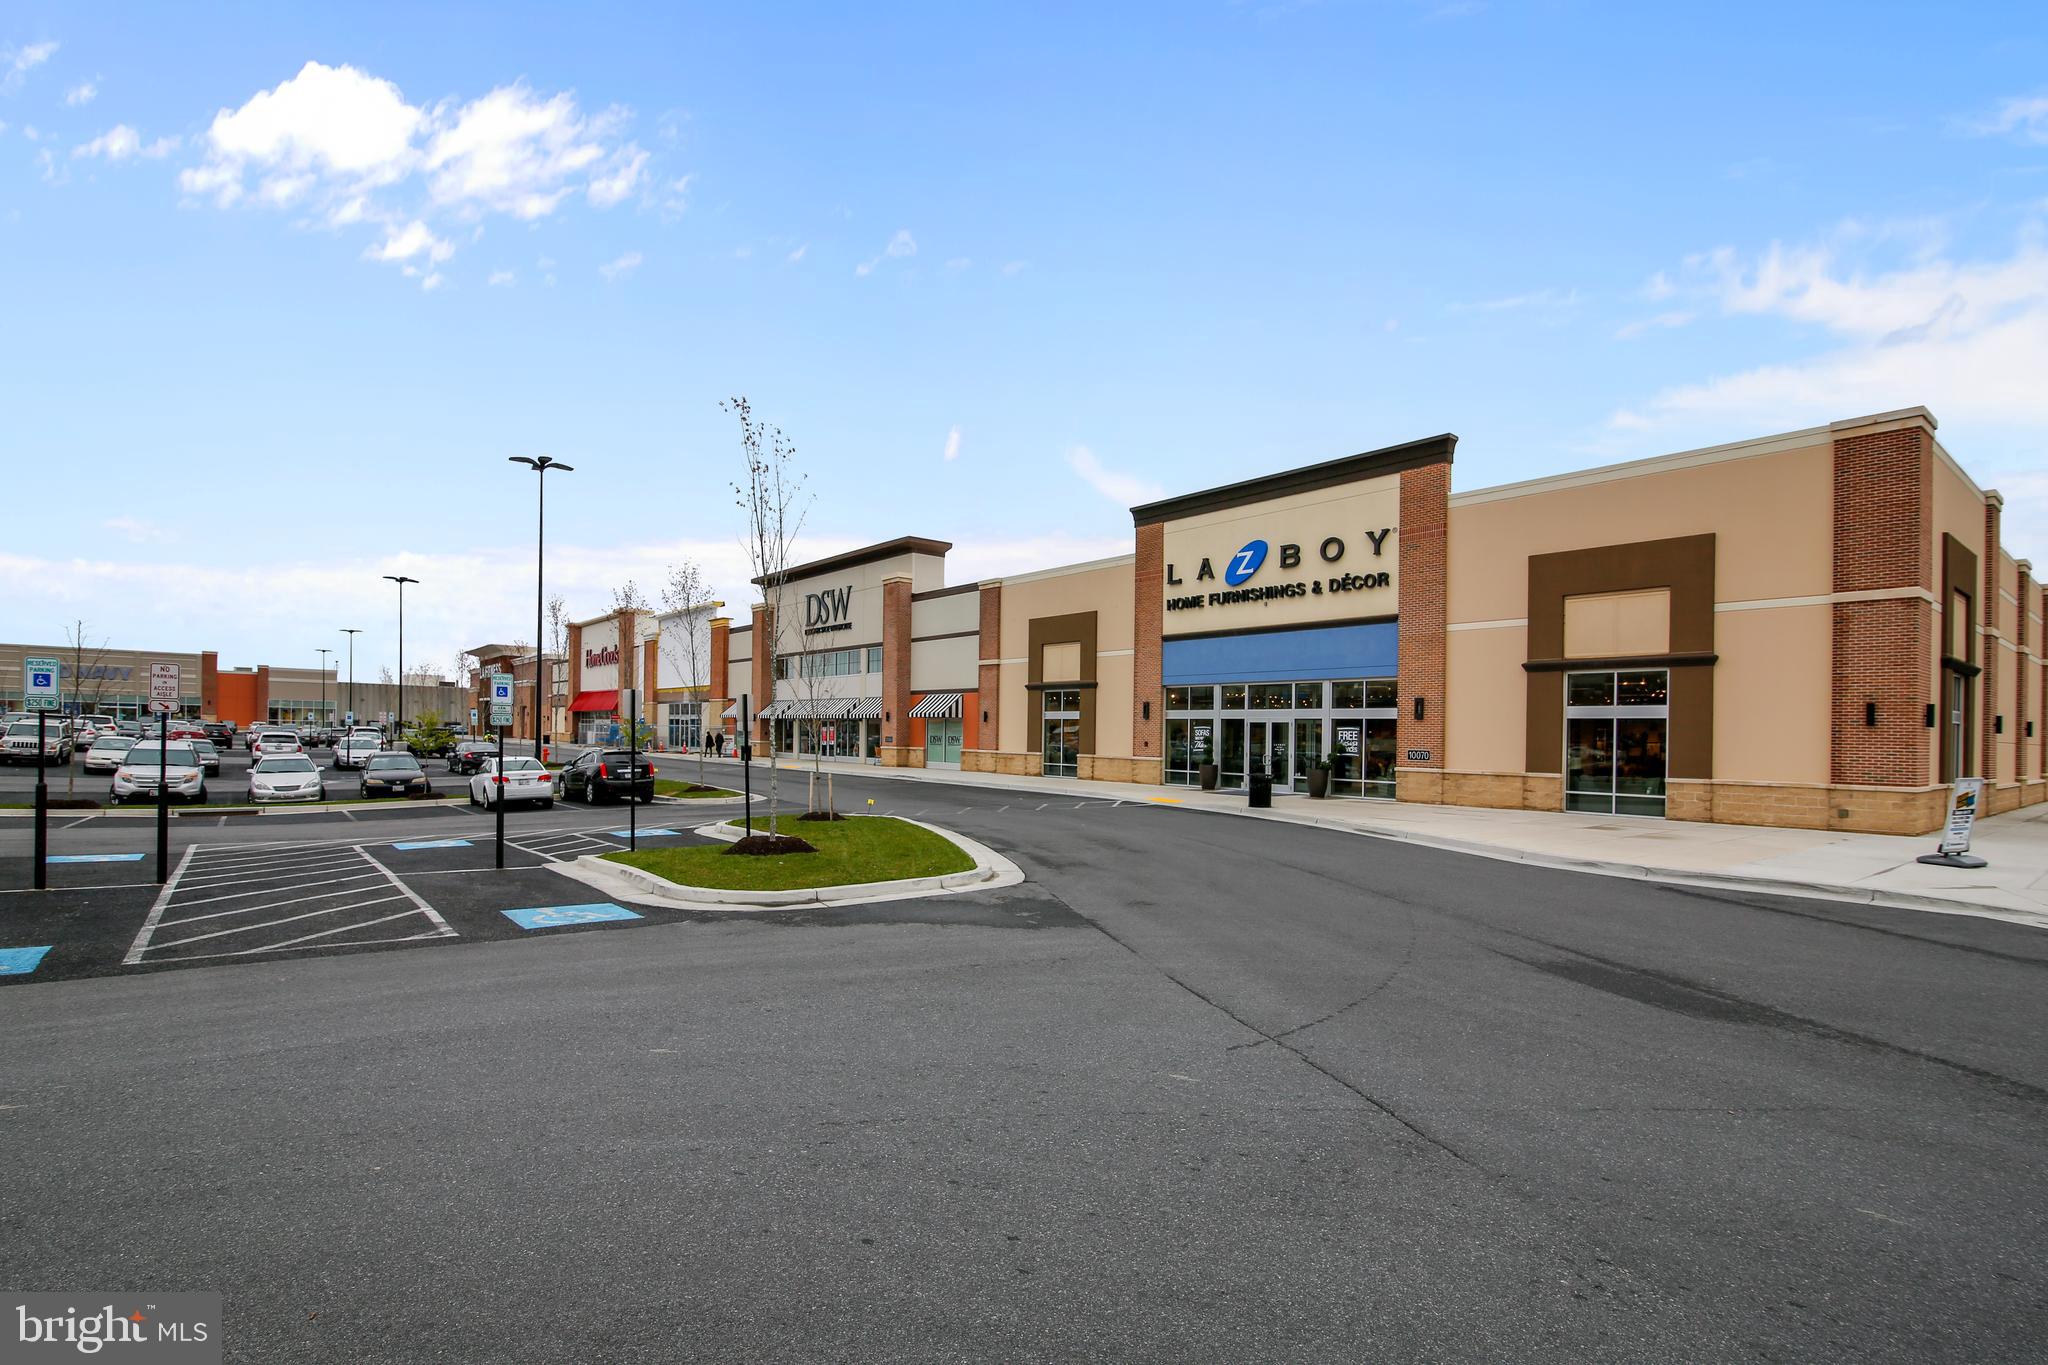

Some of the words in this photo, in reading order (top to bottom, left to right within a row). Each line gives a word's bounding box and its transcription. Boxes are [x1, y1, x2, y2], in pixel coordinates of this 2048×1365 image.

[1166, 594, 1205, 611] HOME
[1208, 582, 1307, 606] FURNISHINGS
[1311, 580, 1323, 595] &
[1328, 572, 1390, 593] DÉCOR
[805, 585, 852, 627] DSW
[929, 735, 943, 744] DSW
[947, 735, 961, 744] DSW
[1338, 731, 1358, 740] FREE
[1409, 751, 1429, 760] 10070
